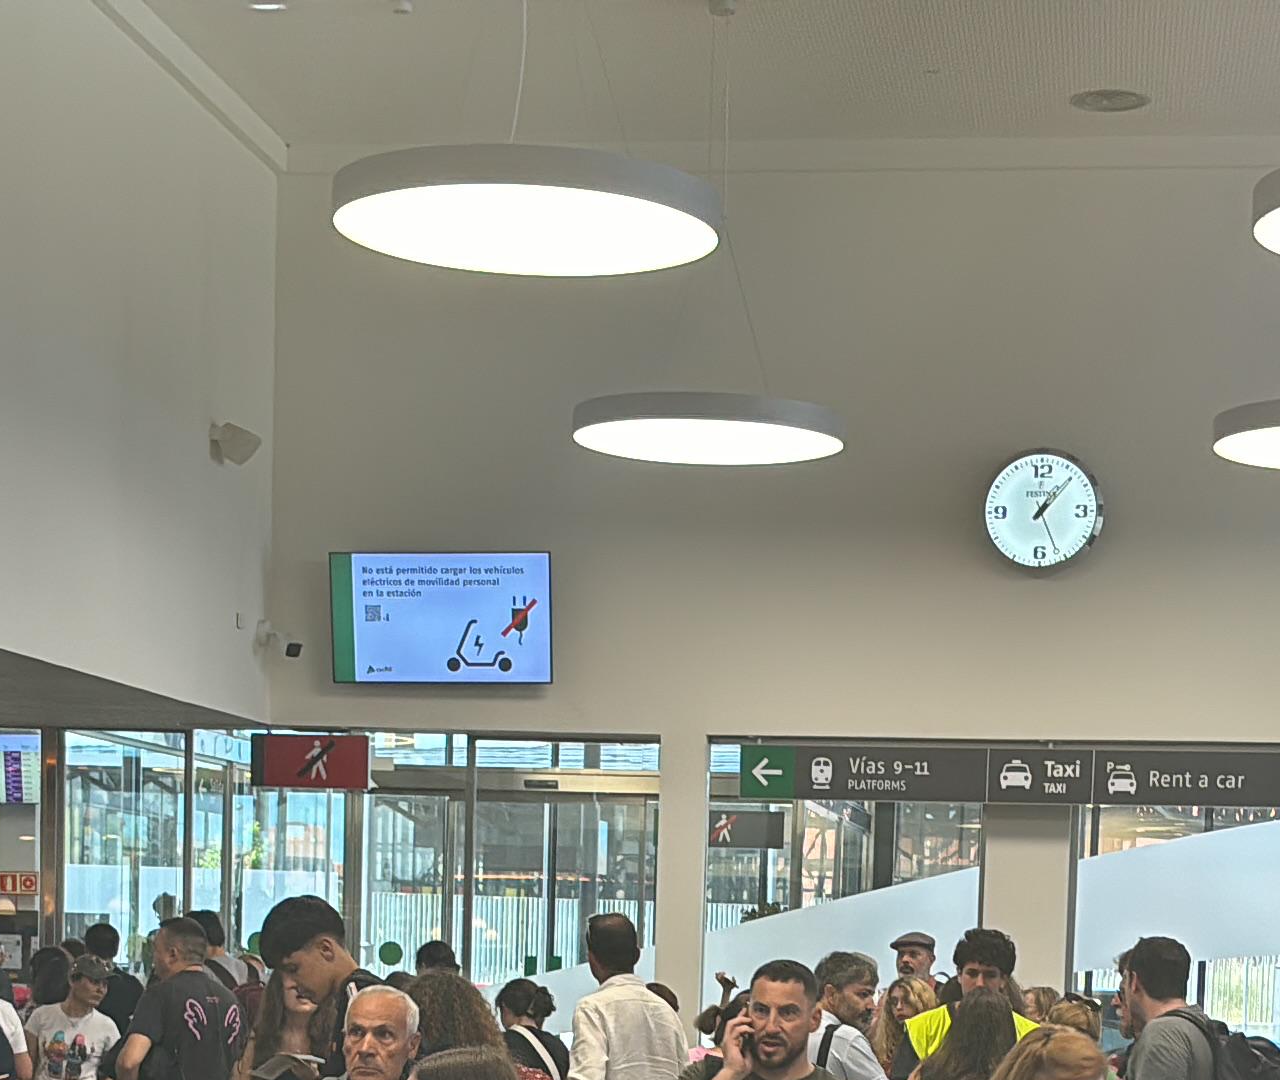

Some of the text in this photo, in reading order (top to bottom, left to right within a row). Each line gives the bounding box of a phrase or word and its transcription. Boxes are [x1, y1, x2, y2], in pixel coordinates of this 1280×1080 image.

[1031, 464, 1053, 479] 12
[993, 504, 1089, 520] 9 3
[1033, 545, 1047, 560] 6
[361, 565, 525, 577] No está permitido cargar los vehículos
[361, 577, 500, 588] eléctricos de movilidad personal
[362, 588, 422, 598] en la estación
[848, 755, 930, 777] Vías 9-11
[1043, 759, 1082, 779] Taxi
[847, 778, 908, 792] PLATFORMS
[1148, 769, 1246, 790] Rent a car
[1042, 782, 1068, 795] TAXI
